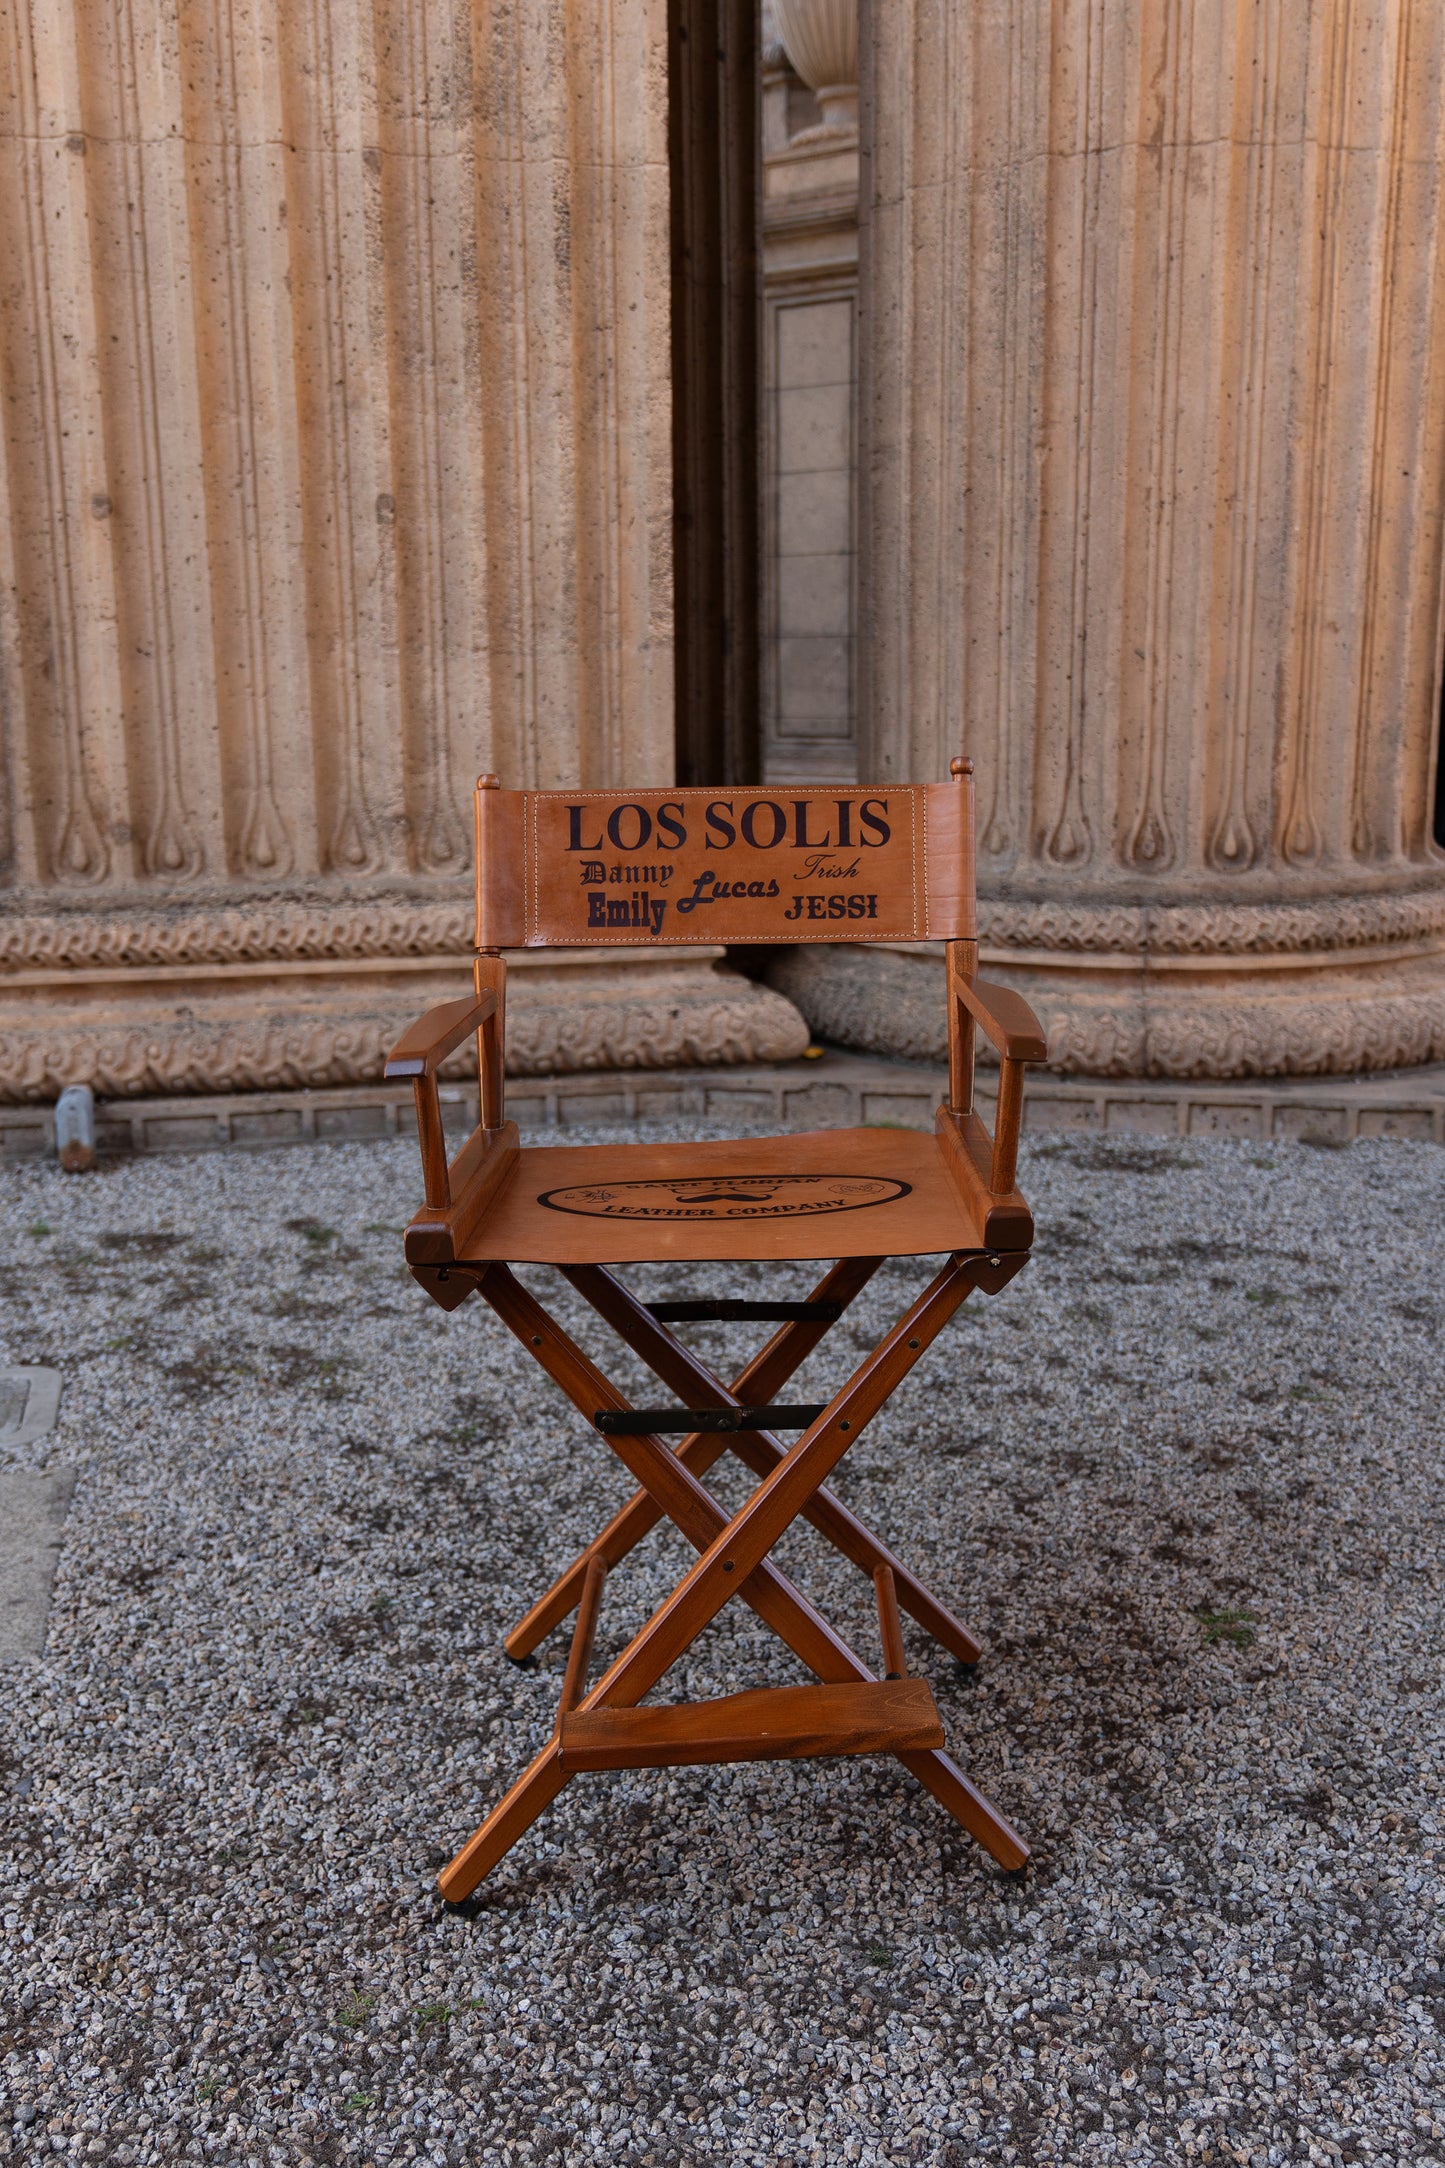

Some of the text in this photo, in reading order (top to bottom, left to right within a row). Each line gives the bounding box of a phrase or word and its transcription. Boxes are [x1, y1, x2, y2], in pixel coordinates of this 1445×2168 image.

[564, 799, 891, 850] LOS SOLIS
[579, 860, 674, 887] Danny
[793, 854, 861, 880] Trish
[676, 870, 780, 913] Lucas
[587, 891, 667, 935] Emily
[784, 895, 878, 920] JESSI
[711, 1179, 823, 1187] FLORIAN
[602, 1199, 845, 1216] LEATHER COMPANY
